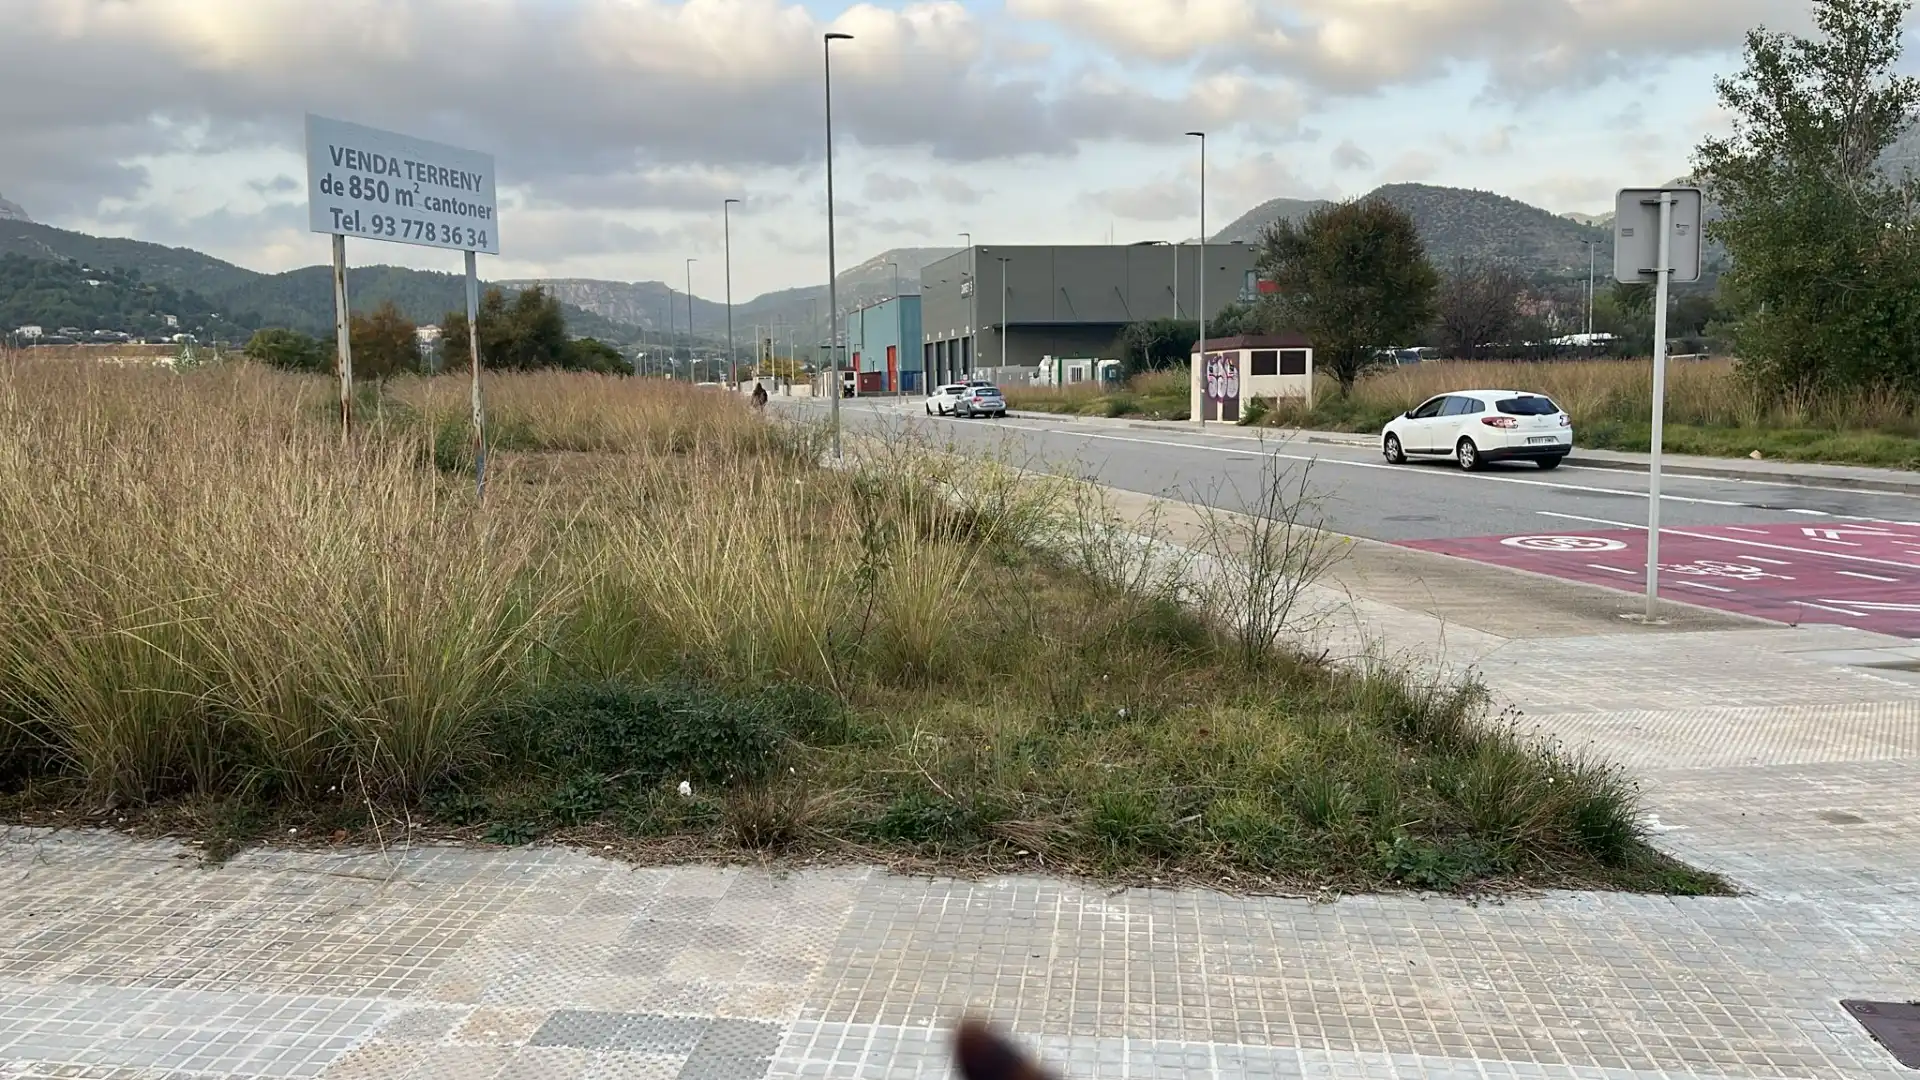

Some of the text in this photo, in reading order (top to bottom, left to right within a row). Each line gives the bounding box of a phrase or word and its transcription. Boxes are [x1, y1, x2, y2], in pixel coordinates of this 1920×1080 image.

[329, 144, 482, 193] VENDA TERRENY
[320, 173, 344, 197] de
[349, 175, 390, 204] 850
[424, 195, 492, 220] cantoner
[330, 207, 488, 248] Tel. 93 778 36 34
